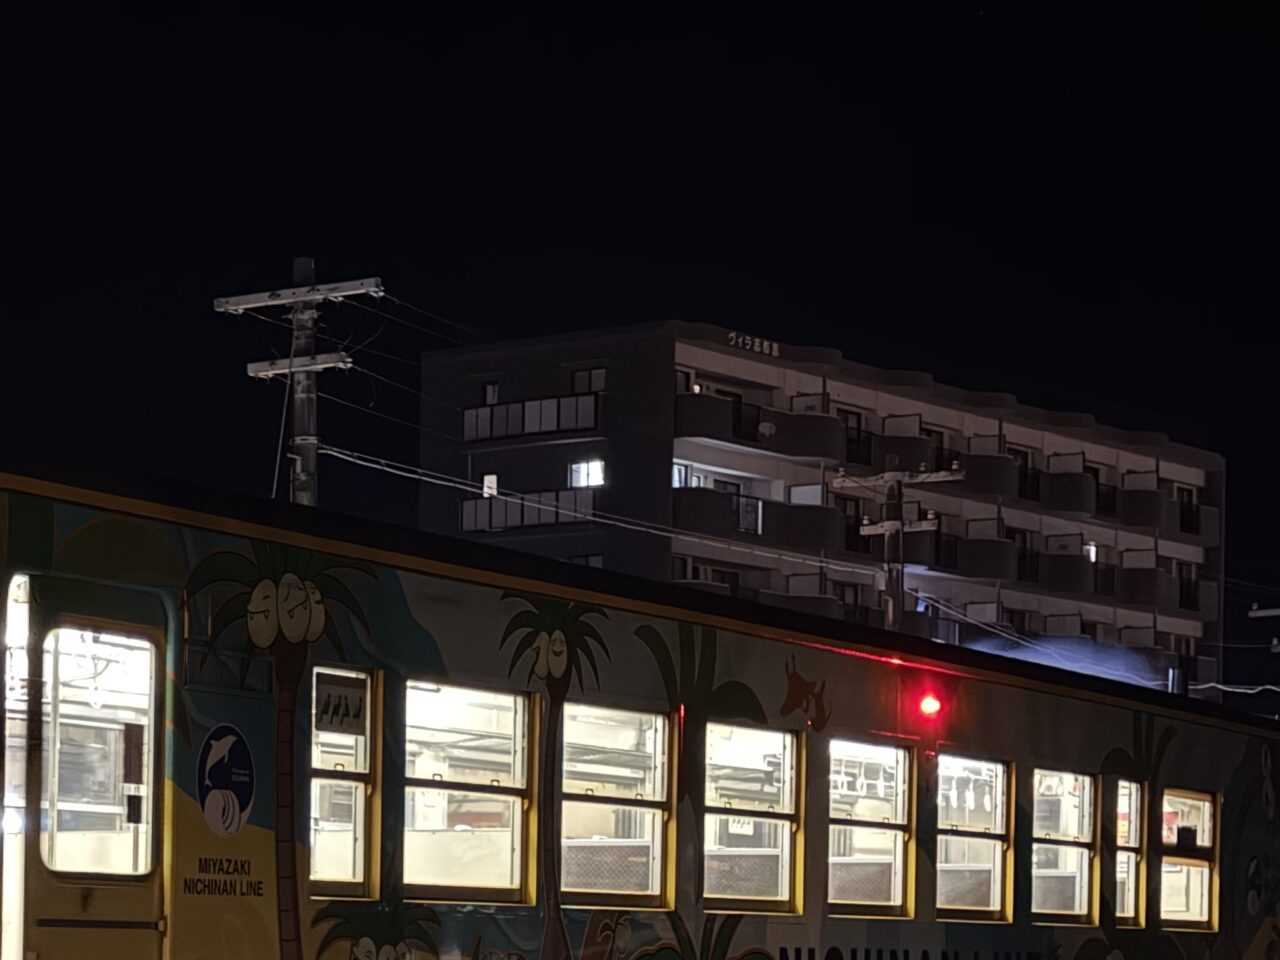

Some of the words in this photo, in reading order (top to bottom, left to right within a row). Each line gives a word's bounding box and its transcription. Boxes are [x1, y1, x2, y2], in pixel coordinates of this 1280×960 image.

[198, 857, 251, 876] MIYAZAKI
[184, 878, 236, 896] NICHINAN
[240, 882, 264, 897] LINE
